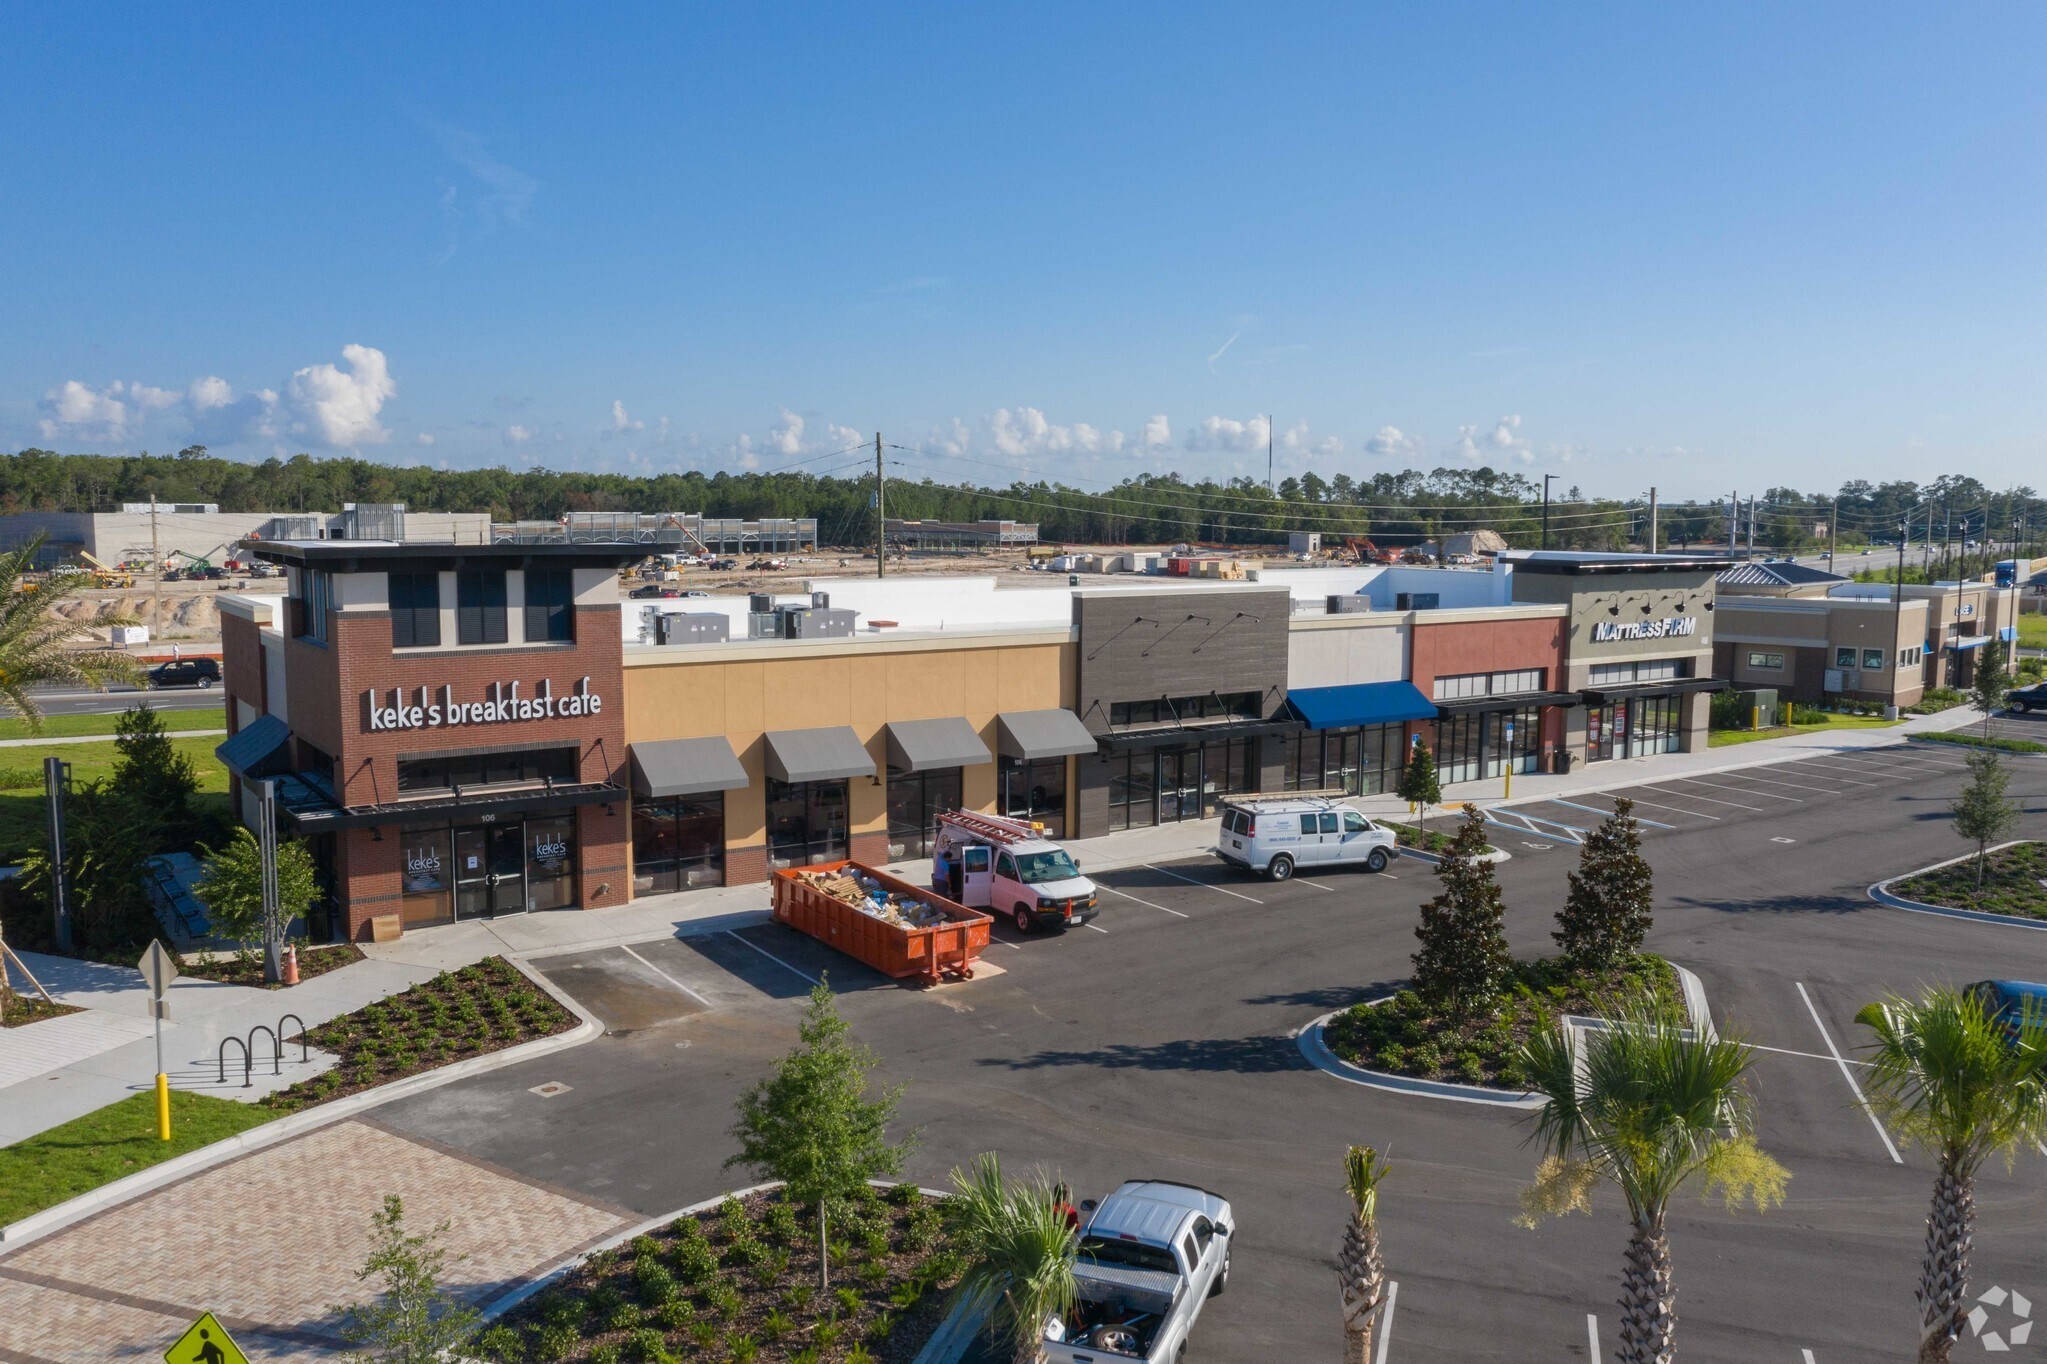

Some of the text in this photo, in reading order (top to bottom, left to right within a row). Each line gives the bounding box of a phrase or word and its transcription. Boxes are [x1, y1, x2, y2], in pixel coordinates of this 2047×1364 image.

[370, 676, 602, 730] keke's breakfast cafe
[481, 813, 496, 822] 106
[536, 832, 566, 856] keke's
[407, 846, 441, 871] keke's
